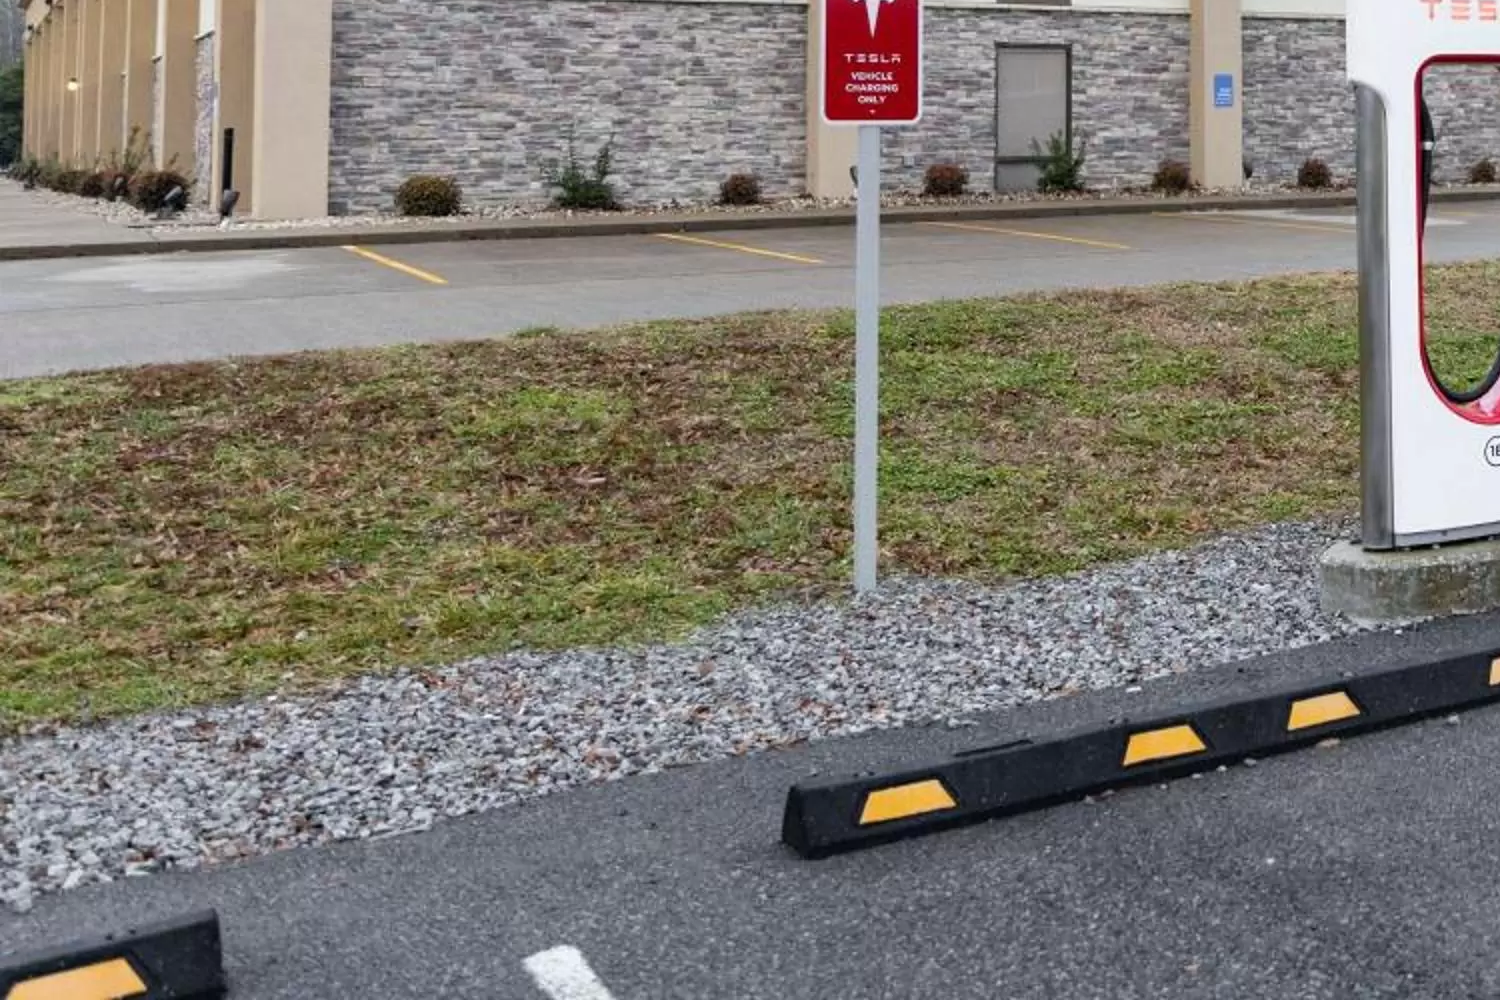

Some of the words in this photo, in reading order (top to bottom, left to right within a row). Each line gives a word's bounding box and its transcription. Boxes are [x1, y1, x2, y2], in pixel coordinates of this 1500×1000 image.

[844, 53, 901, 63] TESLA
[851, 71, 893, 81] VEHICLE
[845, 83, 899, 93] CHARGING
[857, 95, 887, 104] ONLY
